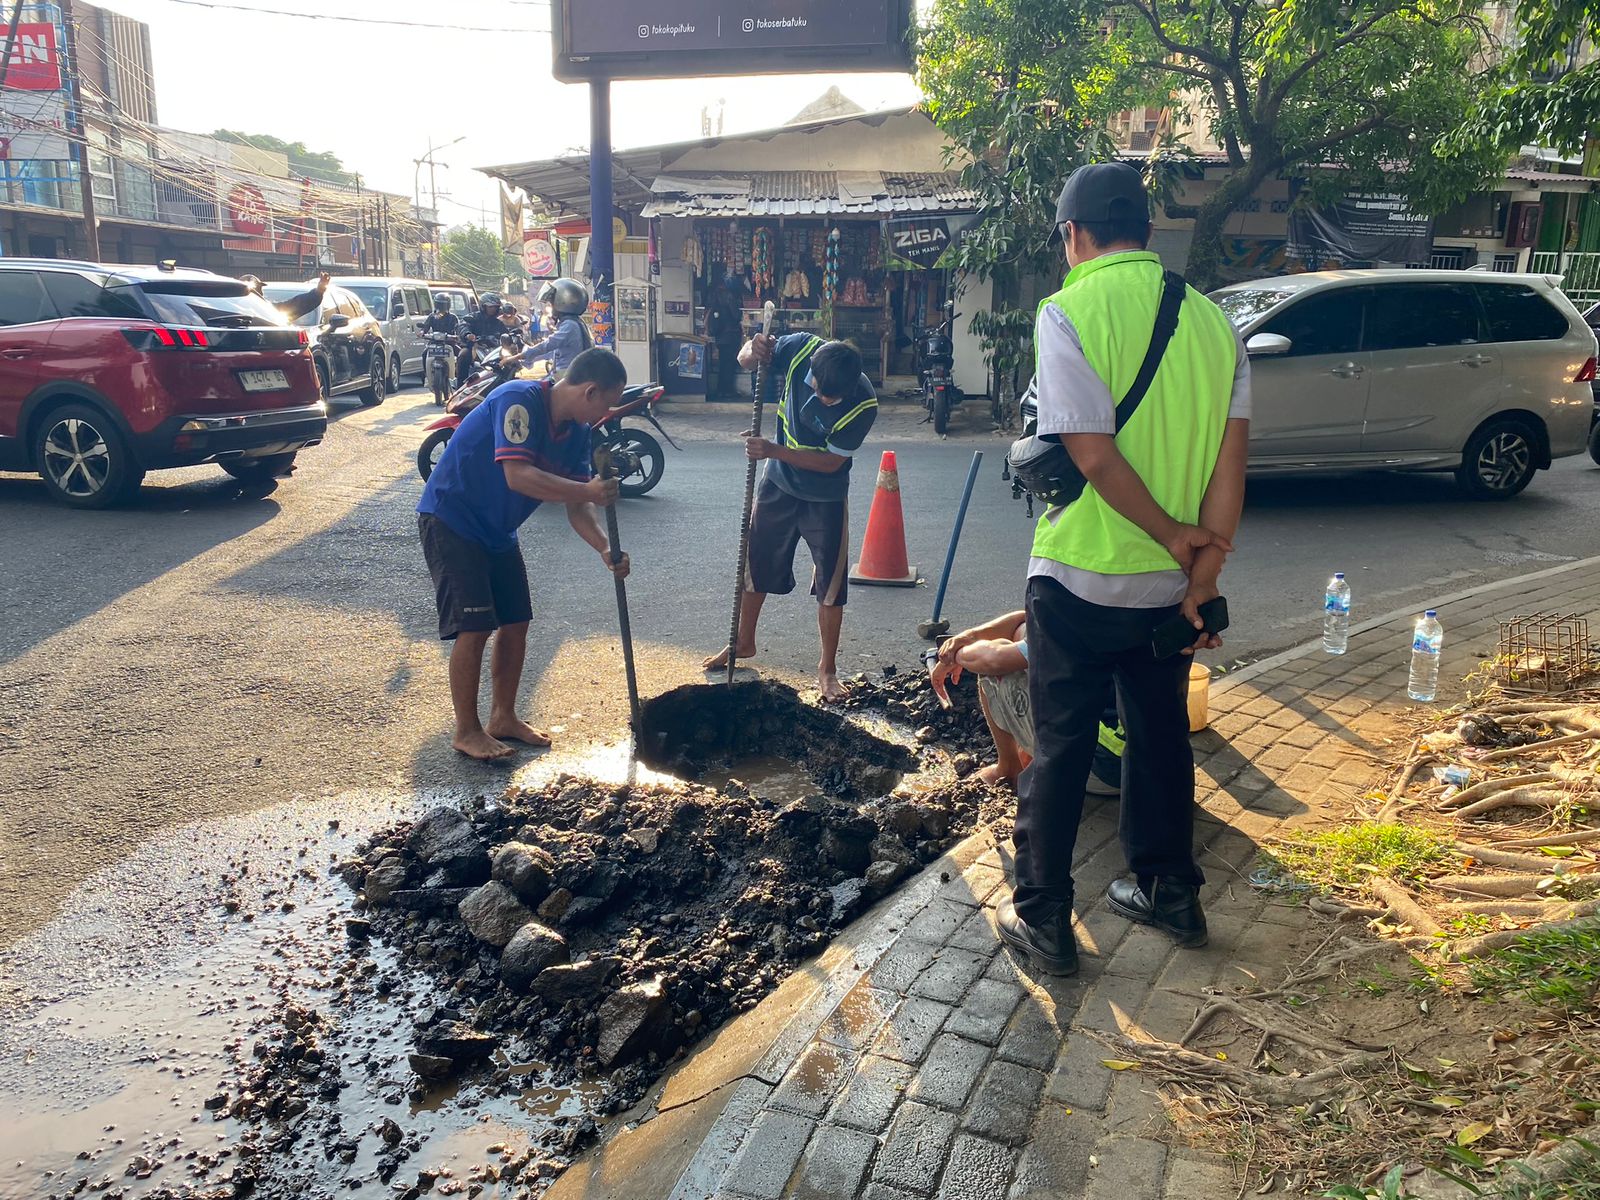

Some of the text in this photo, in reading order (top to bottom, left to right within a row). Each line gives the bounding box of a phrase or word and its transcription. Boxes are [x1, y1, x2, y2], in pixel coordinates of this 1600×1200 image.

[756, 16, 808, 29] tokoserbatuku
[651, 23, 696, 37] tokokopituku
[893, 224, 947, 248] ZIGA
[908, 245, 941, 258] TEH MANIS
